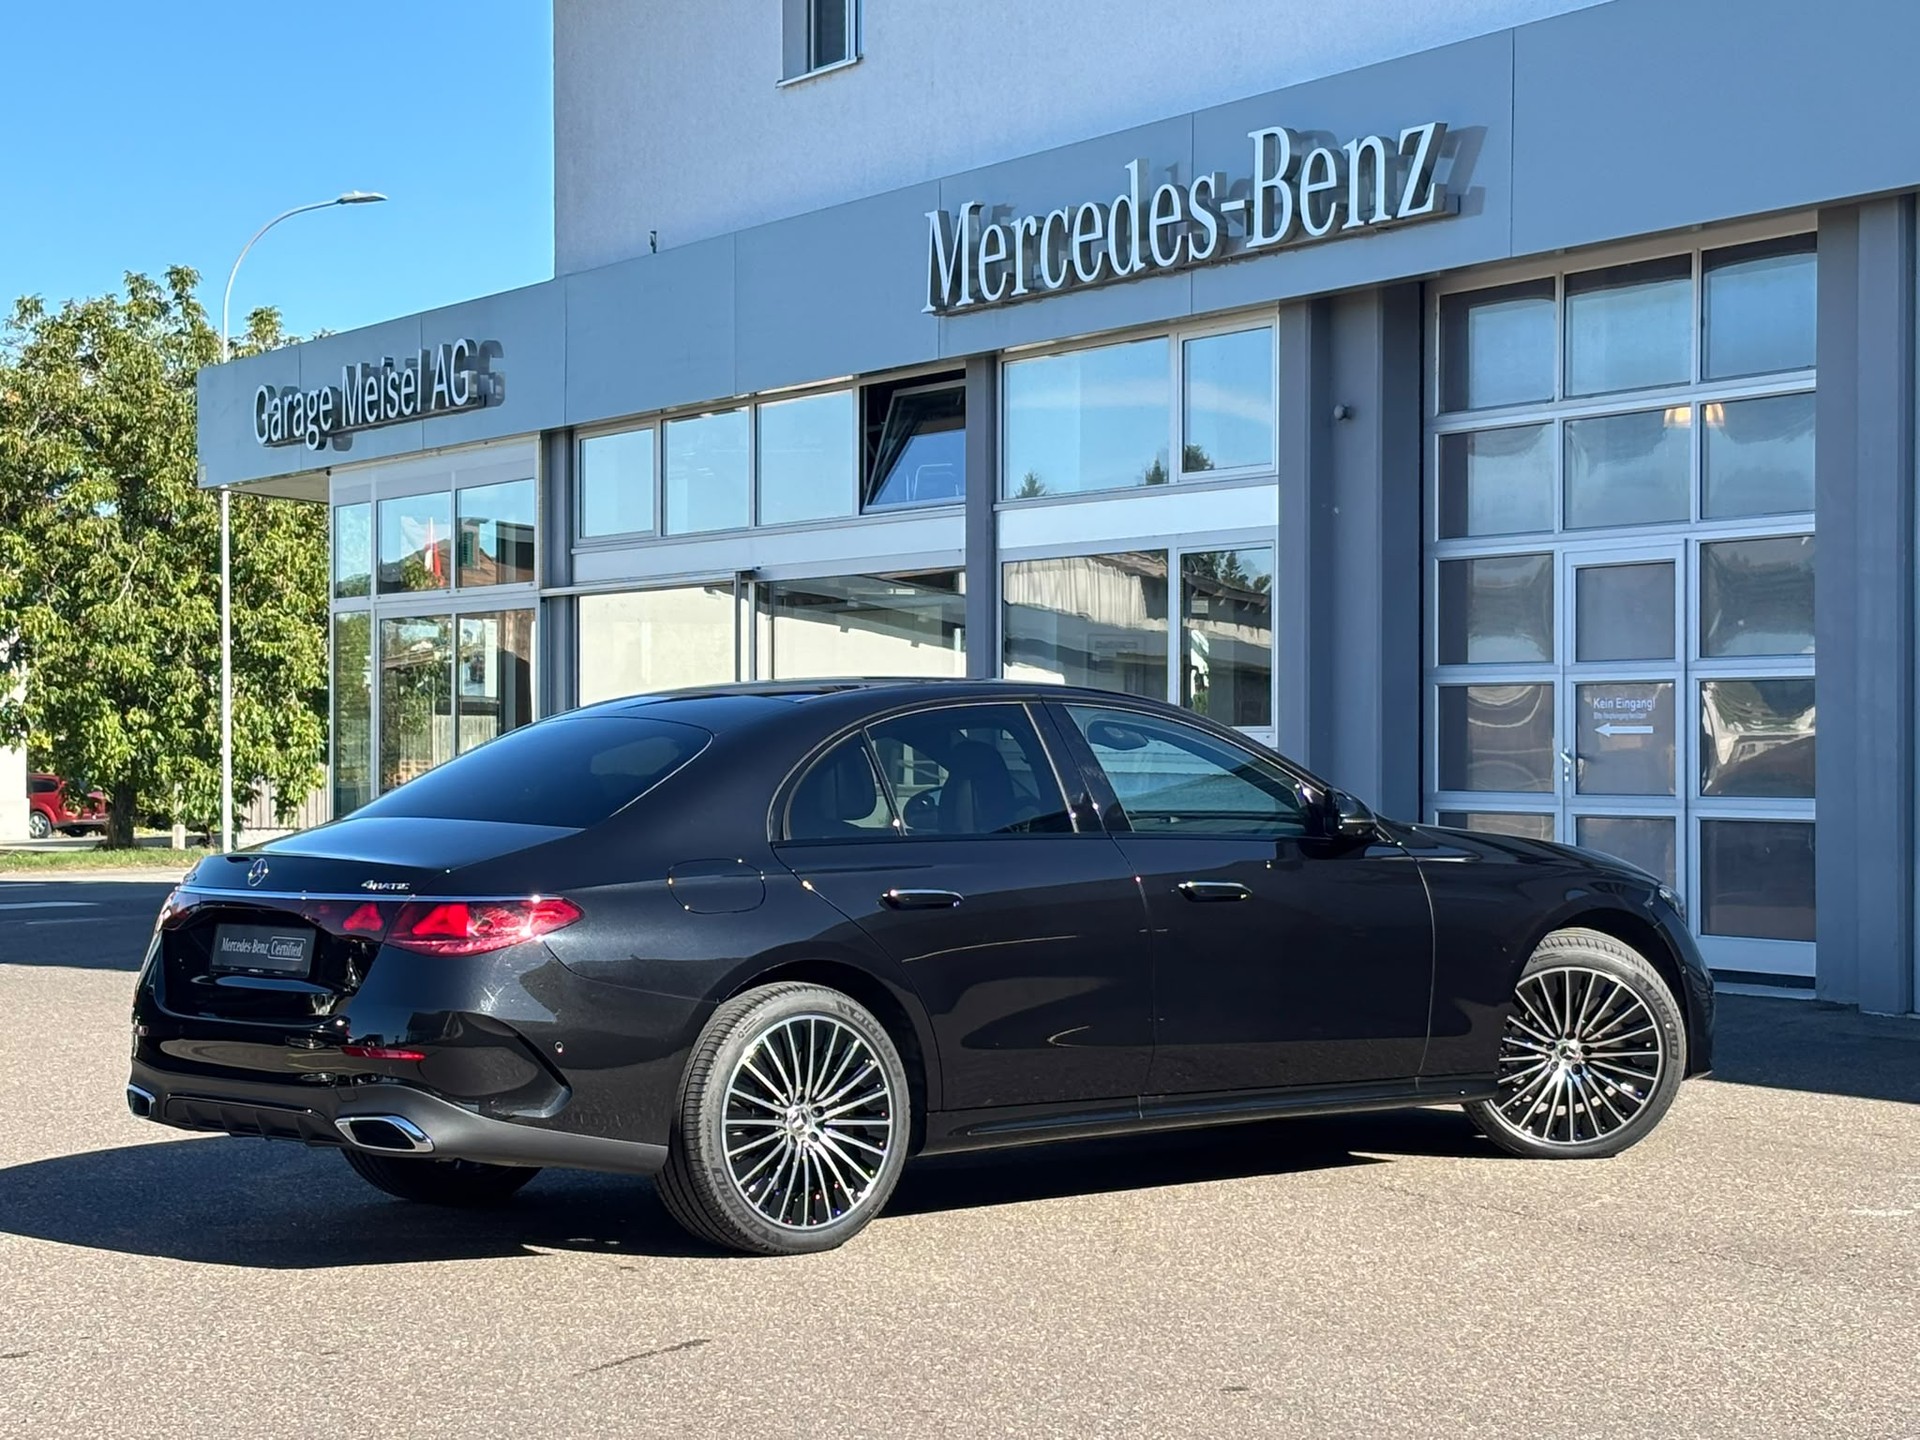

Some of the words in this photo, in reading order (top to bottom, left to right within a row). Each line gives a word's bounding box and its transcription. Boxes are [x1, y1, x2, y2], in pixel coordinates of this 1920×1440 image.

[922, 122, 1446, 313] Mercedes-Benz
[254, 385, 333, 450] Garage
[342, 349, 423, 428] Meisel
[431, 338, 471, 409] AG
[1593, 697, 1614, 709] Kein
[221, 937, 270, 955] Mercedes-Benz
[270, 940, 304, 958] Certified
